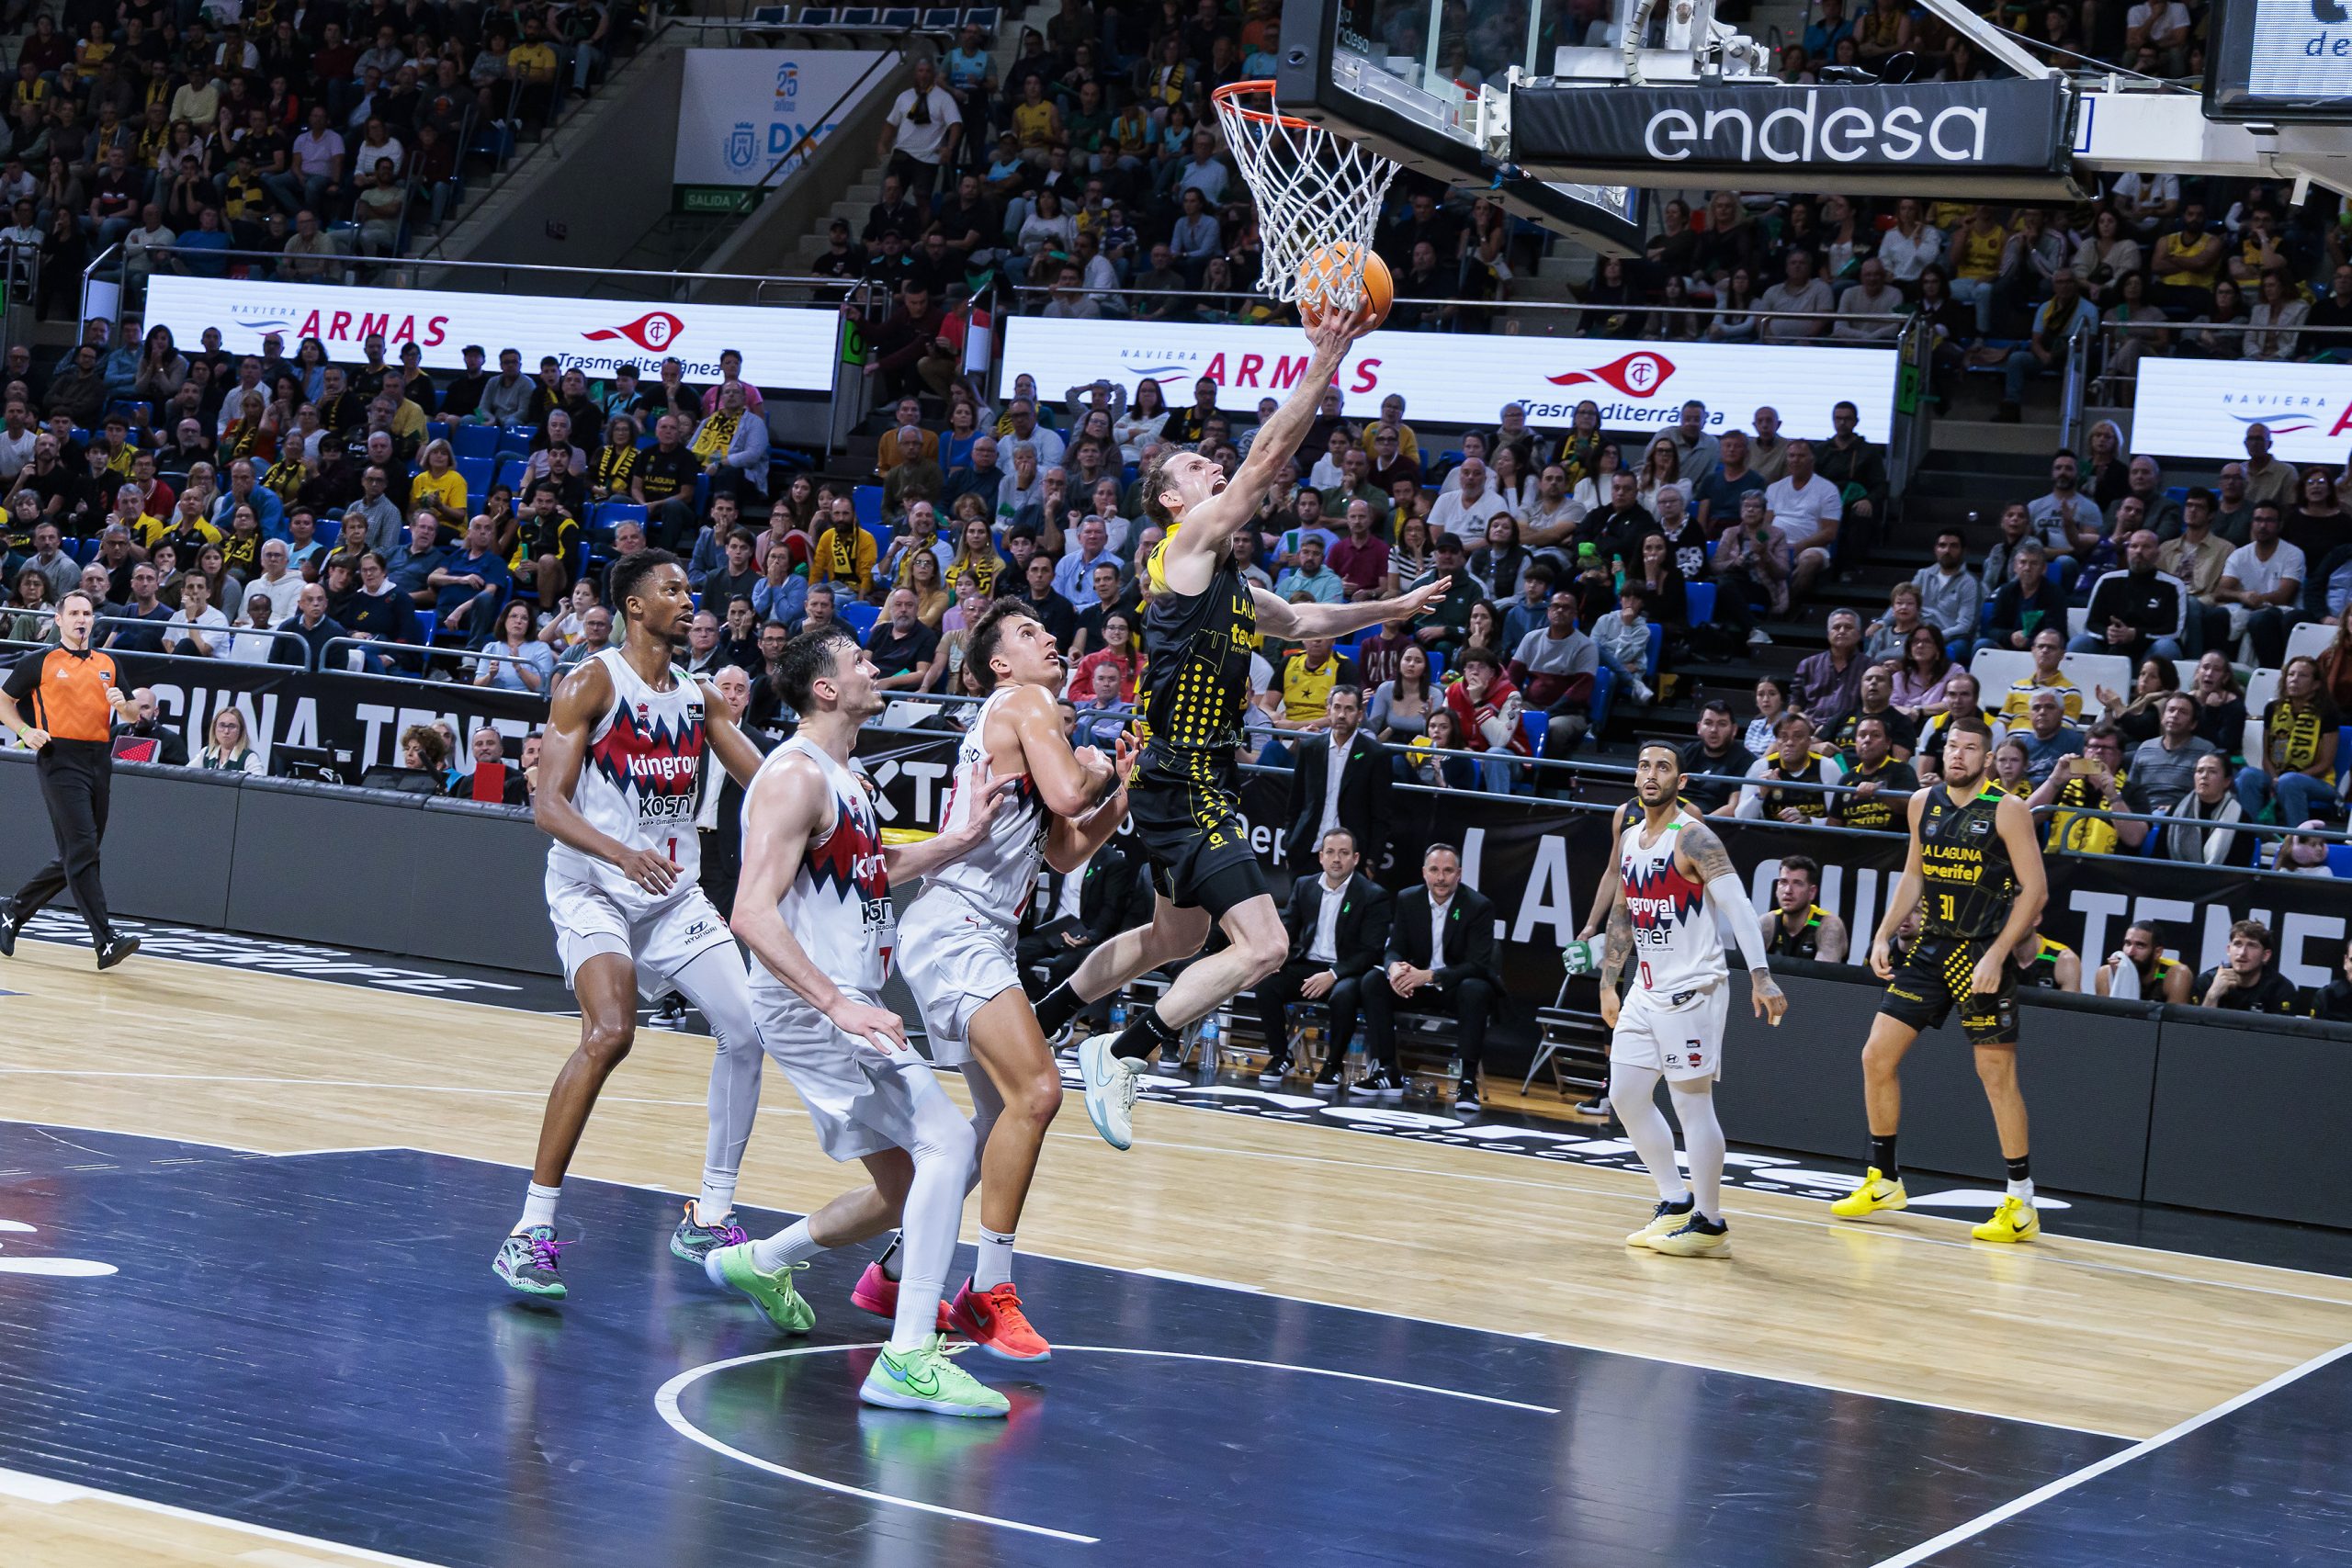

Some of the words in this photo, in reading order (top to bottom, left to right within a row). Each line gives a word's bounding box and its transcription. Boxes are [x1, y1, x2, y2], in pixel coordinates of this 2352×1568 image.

[1644, 89, 1987, 164] endesa
[688, 194, 730, 207] SALIDA
[232, 305, 297, 317] NAVIERA
[297, 310, 449, 346] ARMAS
[558, 353, 721, 376] Trasmediteánea
[1120, 349, 1197, 361] NAVIERA
[1200, 353, 1382, 393] ARMS
[2223, 394, 2325, 407] NAVIERA
[627, 753, 699, 781] kingroy
[1934, 845, 1983, 863] LAGUNA
[1939, 894, 1954, 921] 31
[684, 926, 718, 944] HYUNDAI
